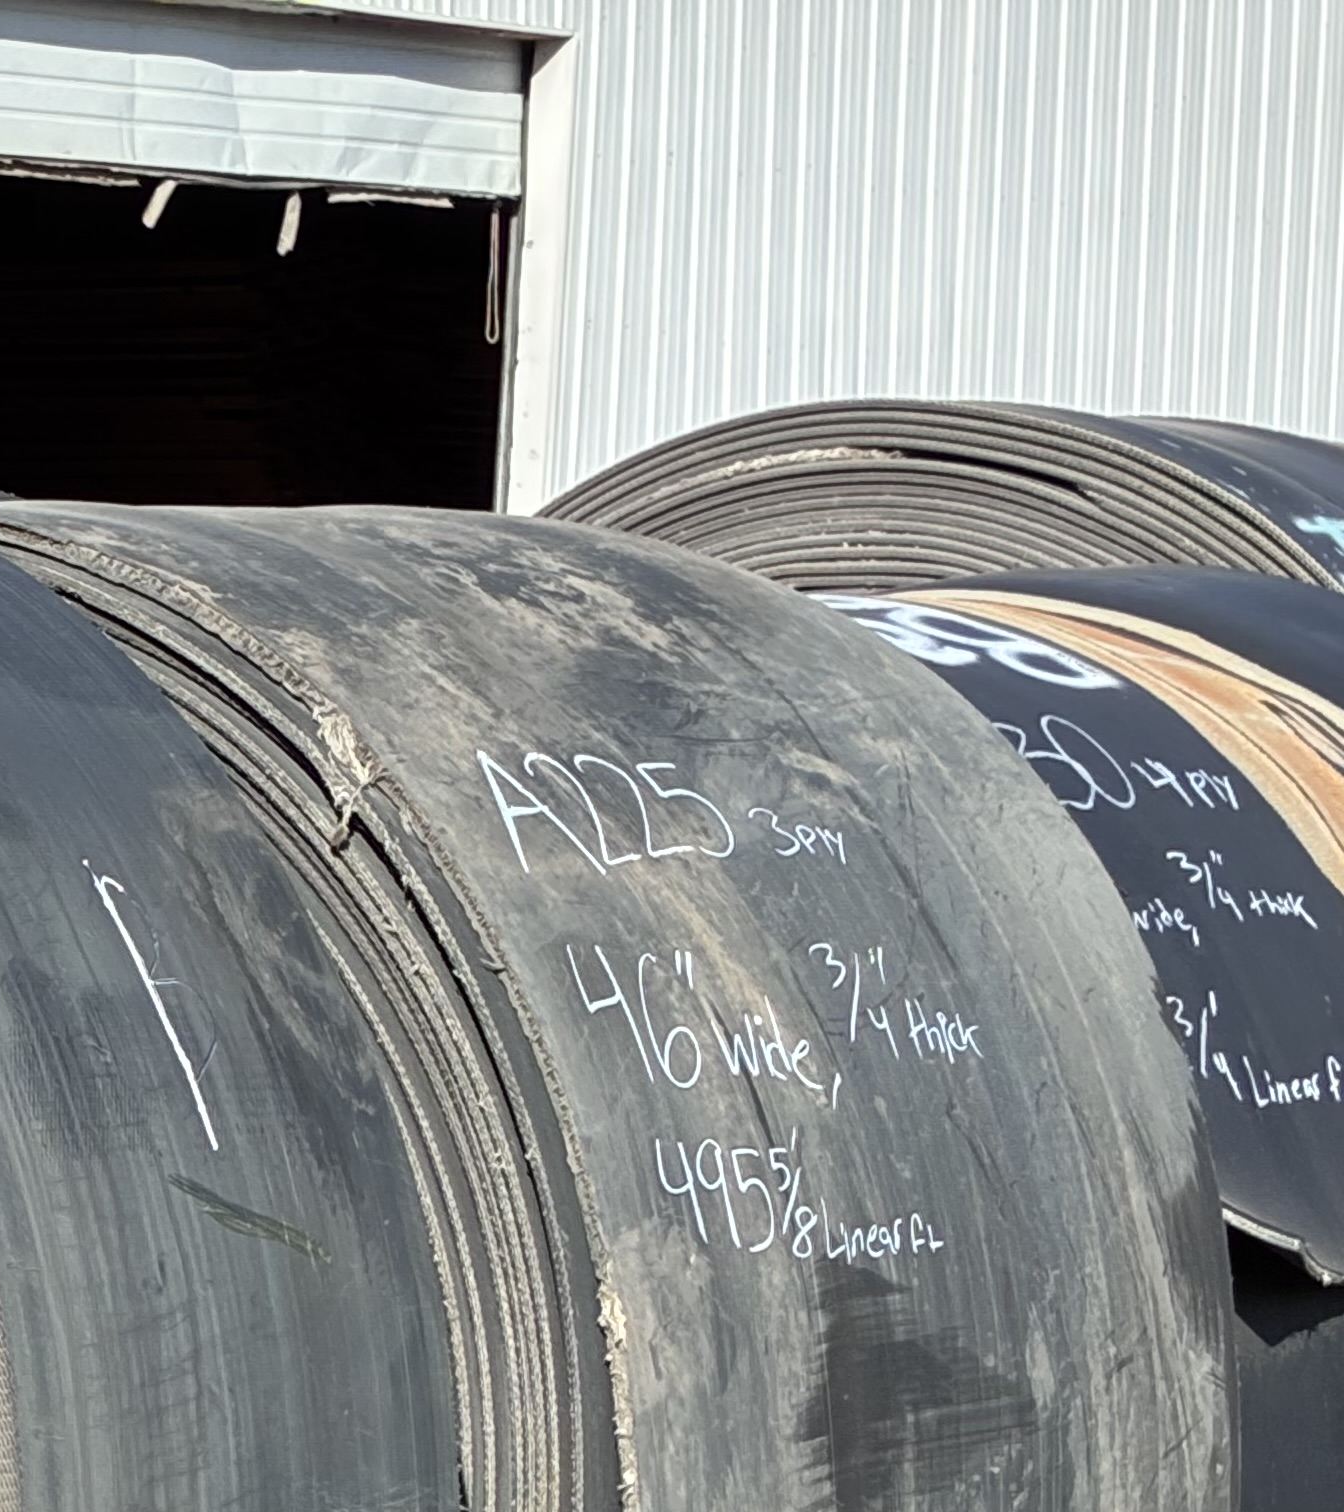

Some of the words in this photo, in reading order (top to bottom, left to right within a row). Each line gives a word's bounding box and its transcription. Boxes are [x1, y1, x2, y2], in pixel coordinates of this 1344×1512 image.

[475, 750, 736, 875] A225
[1247, 888, 1320, 932] thick
[565, 943, 703, 1089] 46"
[904, 997, 985, 1065] thick
[1242, 1055, 1321, 1109] Linear
[820, 1195, 903, 1266] Linear
